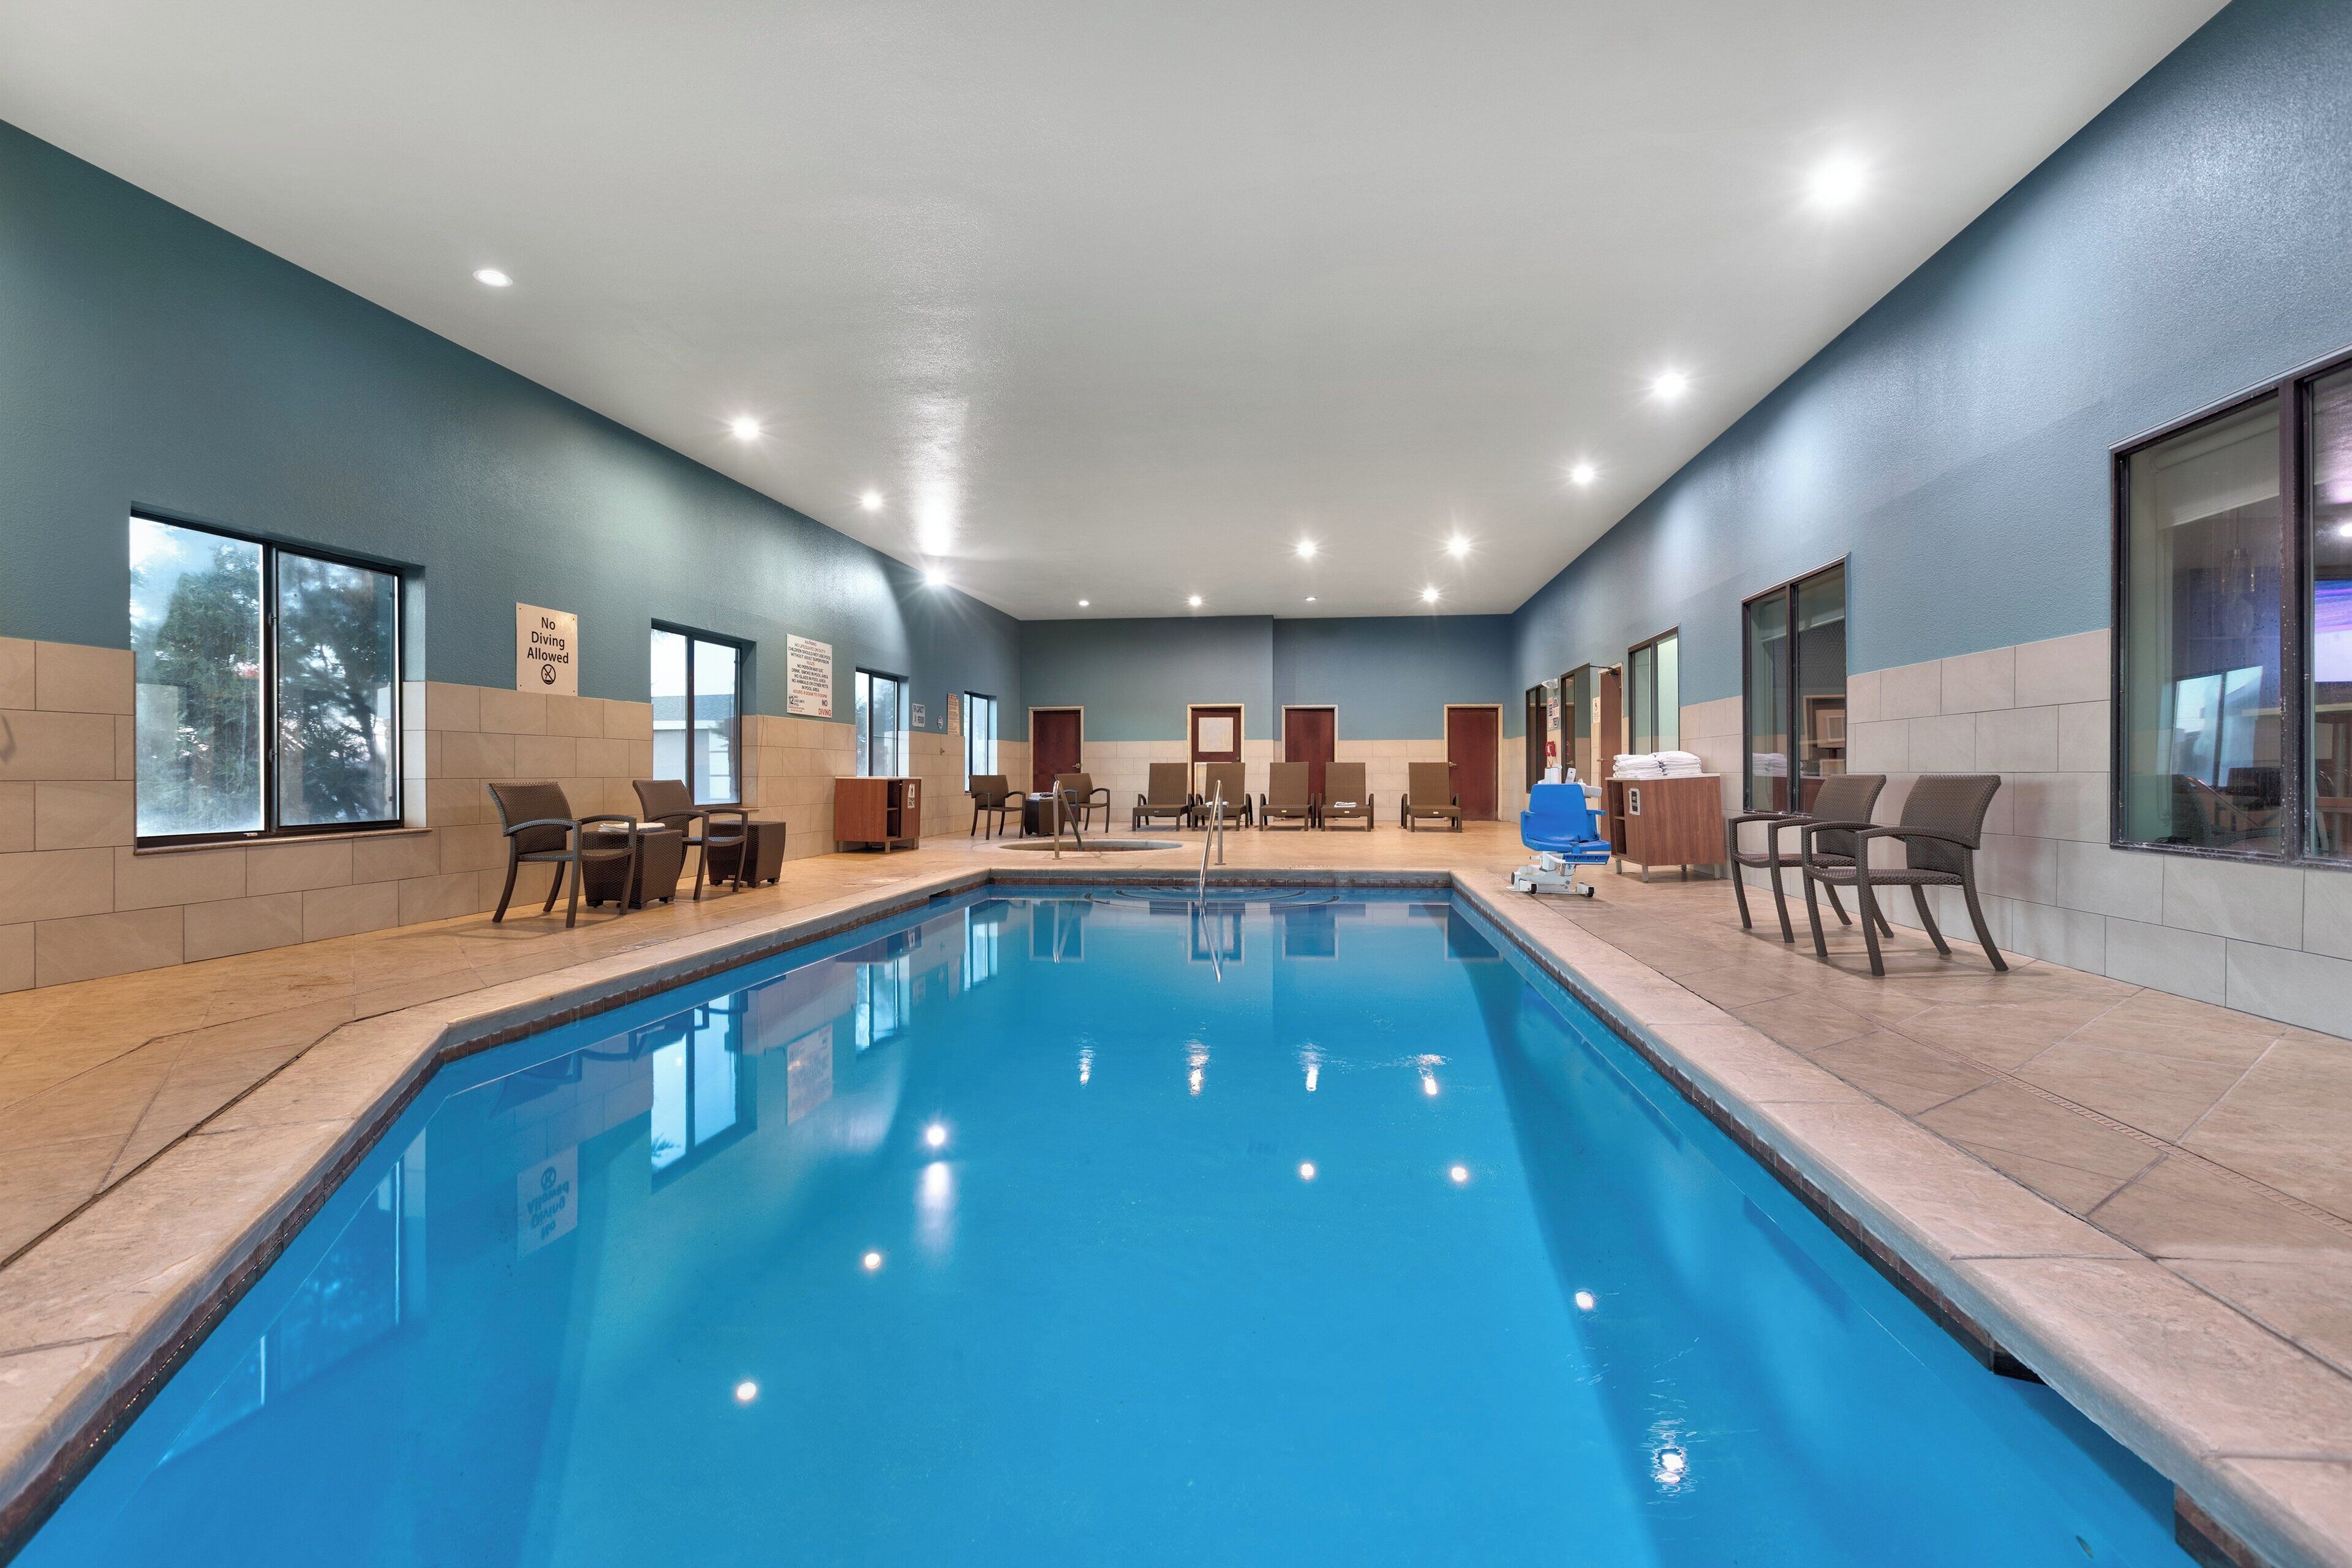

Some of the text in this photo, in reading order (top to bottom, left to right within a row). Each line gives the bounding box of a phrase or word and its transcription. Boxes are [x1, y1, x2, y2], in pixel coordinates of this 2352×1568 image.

[541, 617, 556, 630] No
[532, 631, 565, 650] Diving
[527, 647, 569, 664] Allowed
[788, 695, 794, 704] 12
